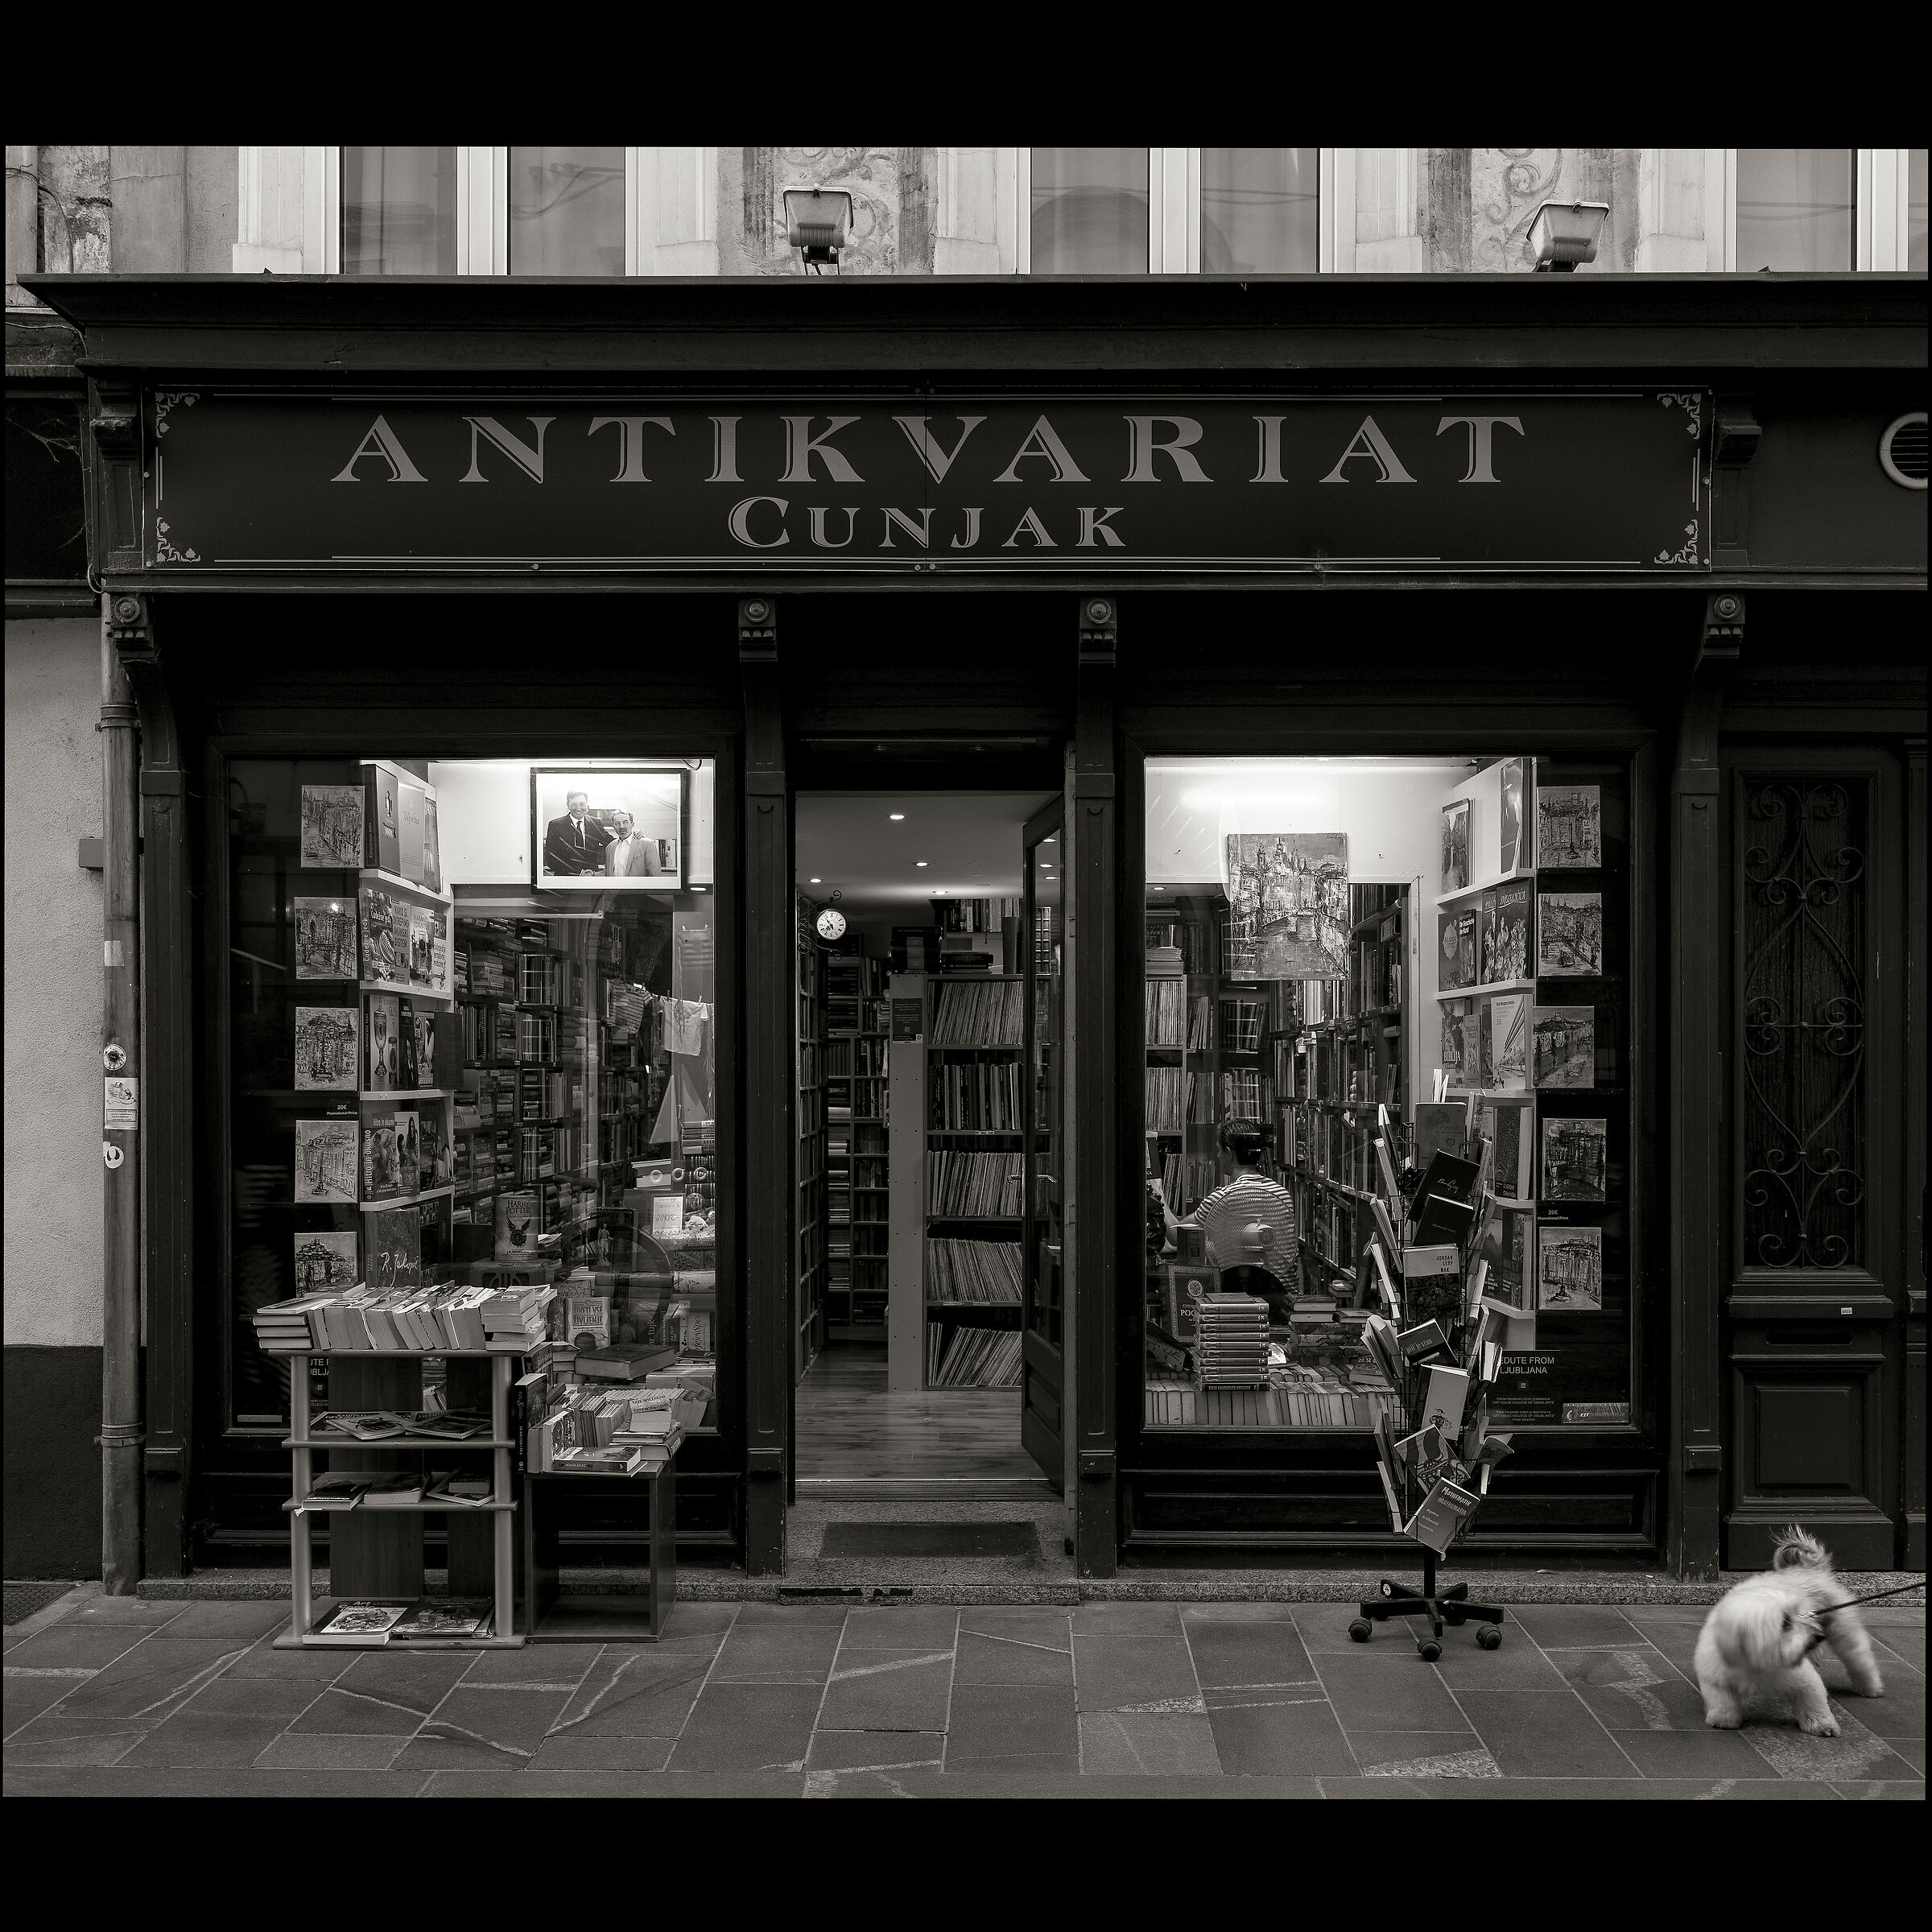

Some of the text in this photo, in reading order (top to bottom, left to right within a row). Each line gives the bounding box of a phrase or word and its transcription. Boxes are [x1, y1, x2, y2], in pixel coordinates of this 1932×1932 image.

[331, 415, 1525, 484] ANTIKVARIAT
[729, 496, 1125, 548] CUNJAK
[1443, 1051, 1461, 1065] BIBLIJA
[507, 1200, 529, 1208] HARRY
[506, 1207, 531, 1215] POTTER
[592, 1305, 603, 1315] VSE
[1500, 1366, 1548, 1374] LJUBLJANA
[1440, 1486, 1472, 1507] MATHEMATIK
